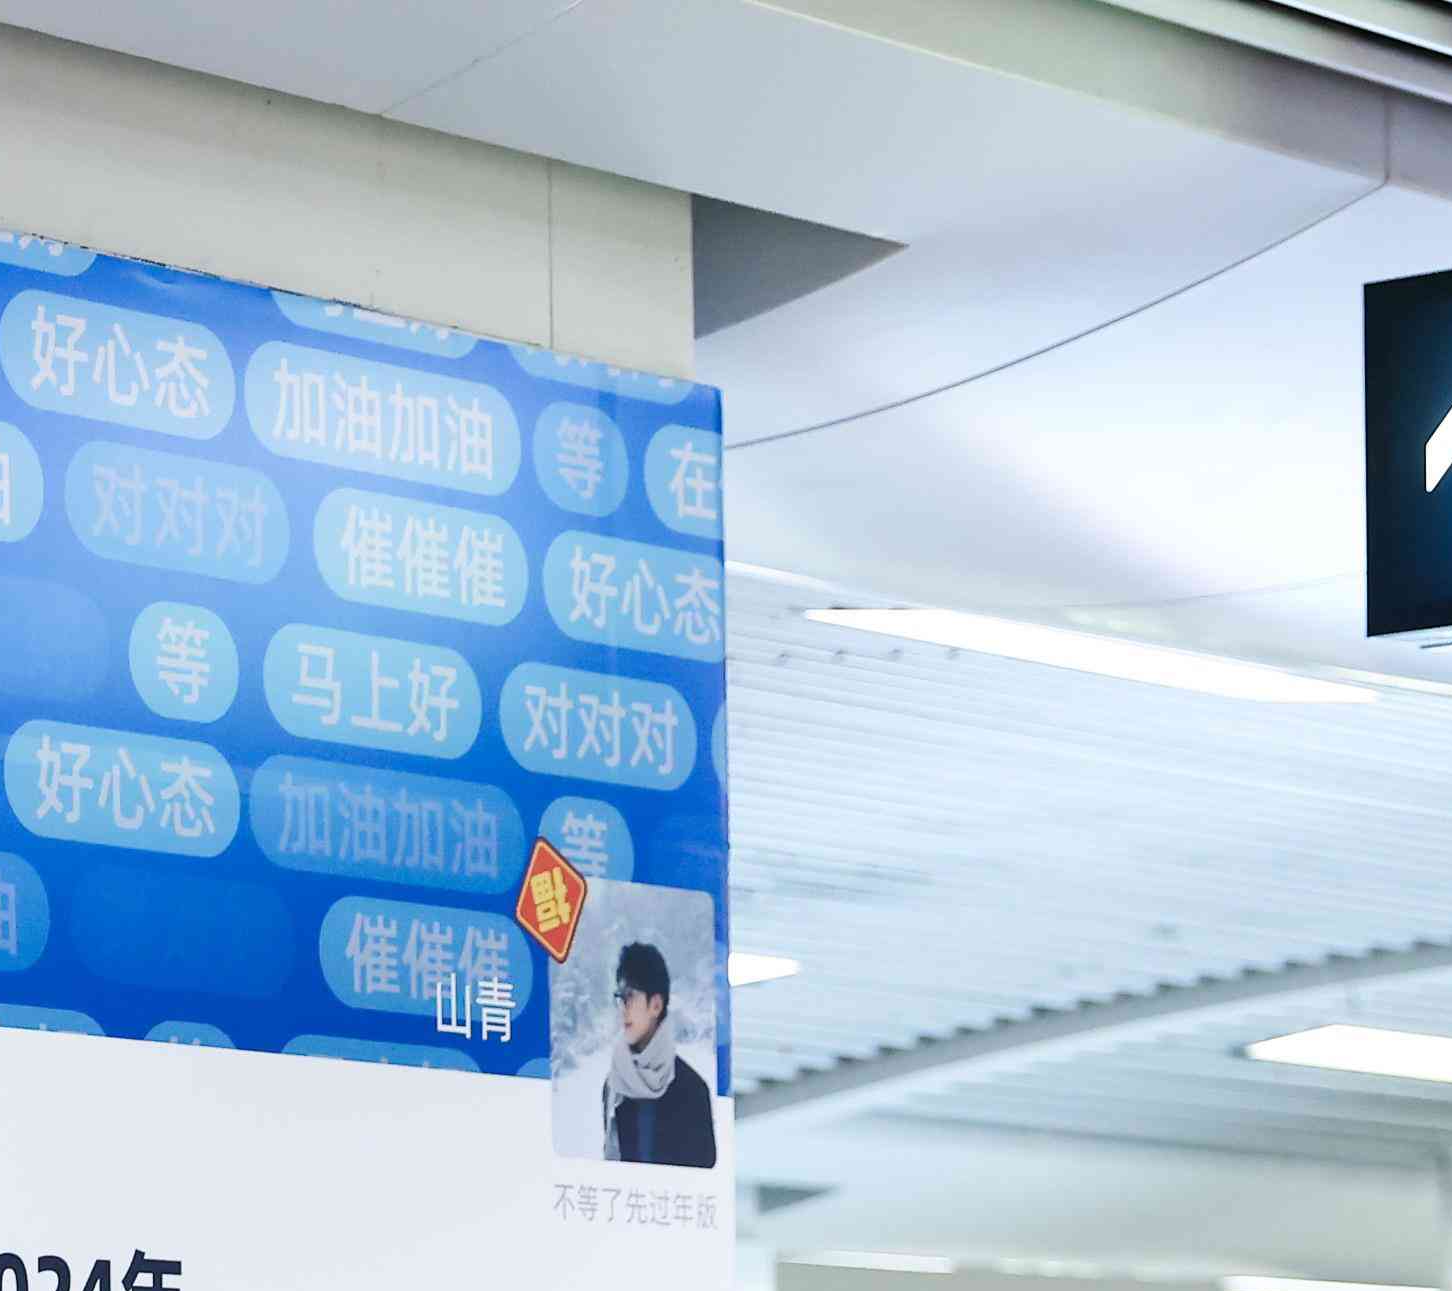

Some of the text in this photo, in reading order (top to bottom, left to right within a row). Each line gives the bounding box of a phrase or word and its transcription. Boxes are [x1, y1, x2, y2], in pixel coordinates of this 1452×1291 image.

[29, 312, 211, 420] 好心态
[272, 359, 493, 482] 加油加油
[556, 417, 604, 498] 等
[91, 463, 269, 568] 对对对
[339, 513, 506, 610] 催催催
[569, 544, 720, 643] 好心态
[156, 617, 211, 704] 等
[291, 641, 460, 738] 马上好
[522, 683, 678, 775] 对对对
[35, 741, 217, 836] 好心态
[277, 782, 497, 877] 加油加油
[345, 915, 511, 1001] 催催催
[436, 973, 516, 1043] 山青
